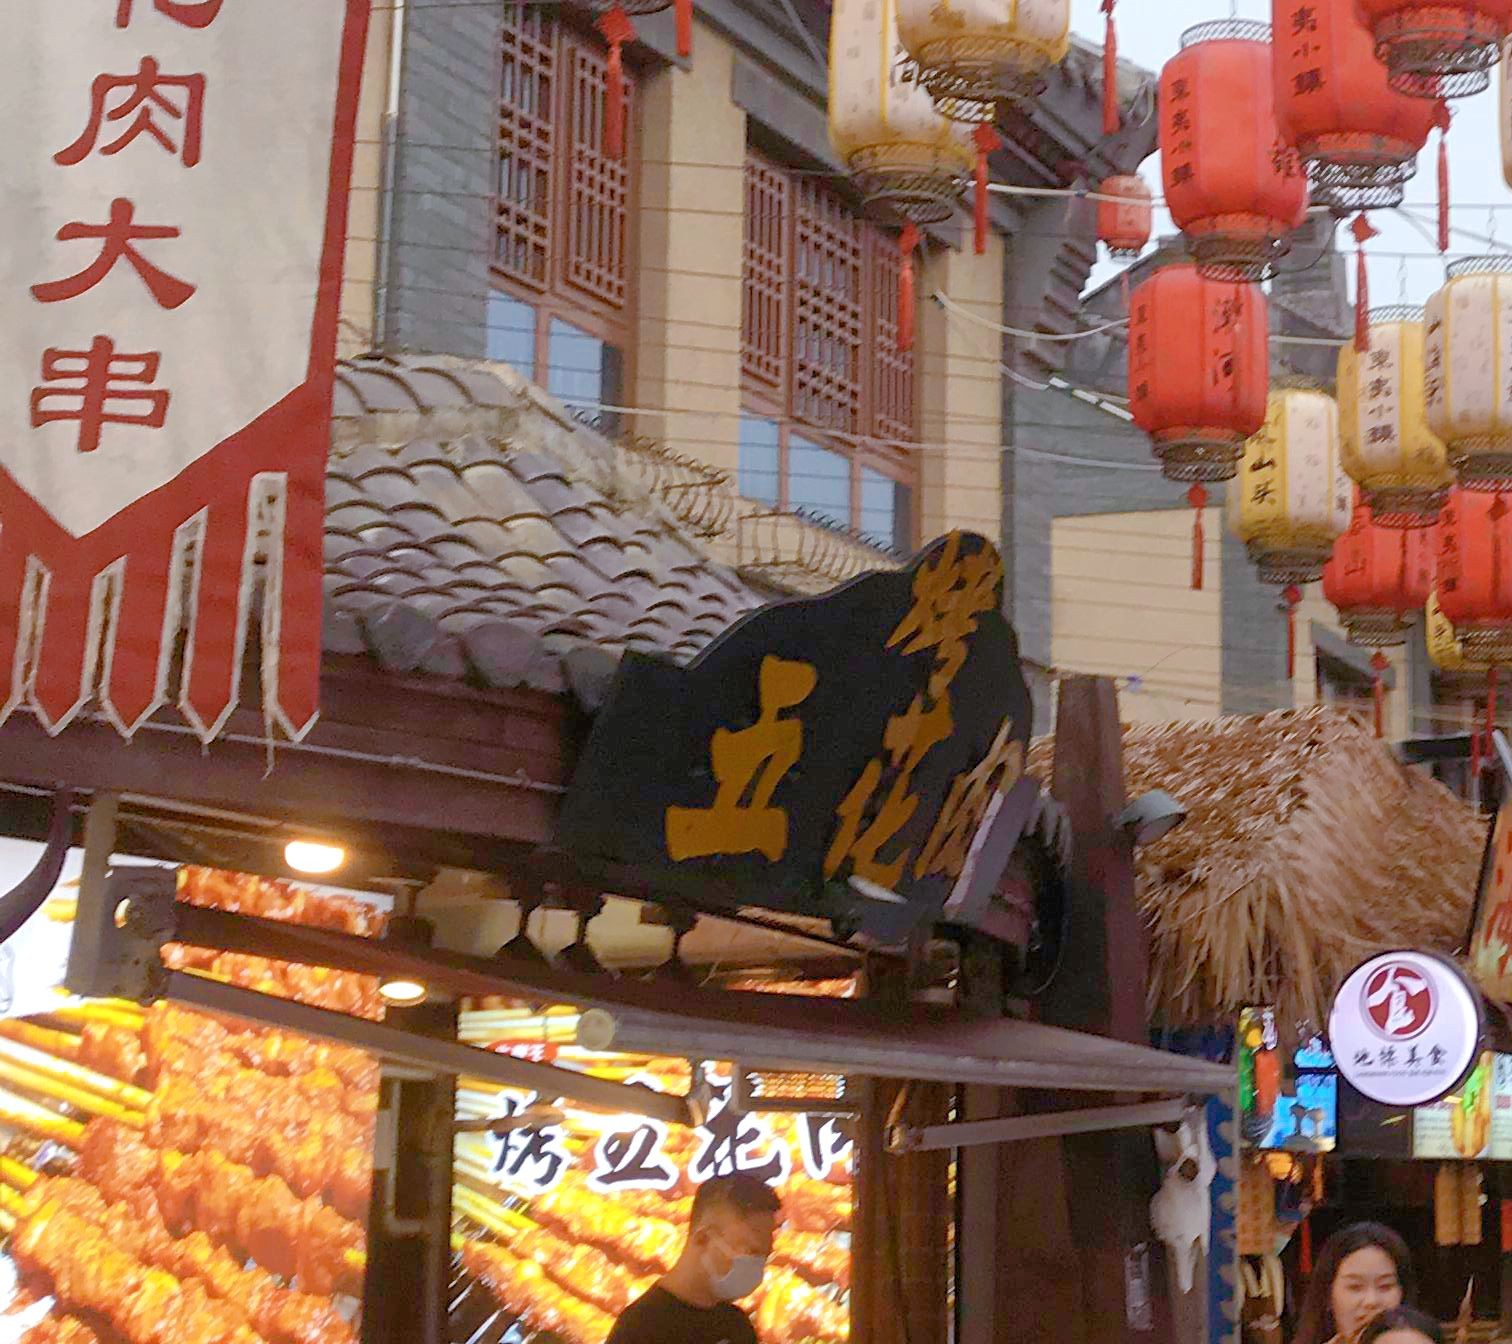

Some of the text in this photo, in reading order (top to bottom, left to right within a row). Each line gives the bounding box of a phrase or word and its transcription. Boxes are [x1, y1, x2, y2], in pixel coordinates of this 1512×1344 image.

[1169, 80, 1197, 188] 東夷小鎮
[1366, 349, 1396, 445] 東夷小鎮
